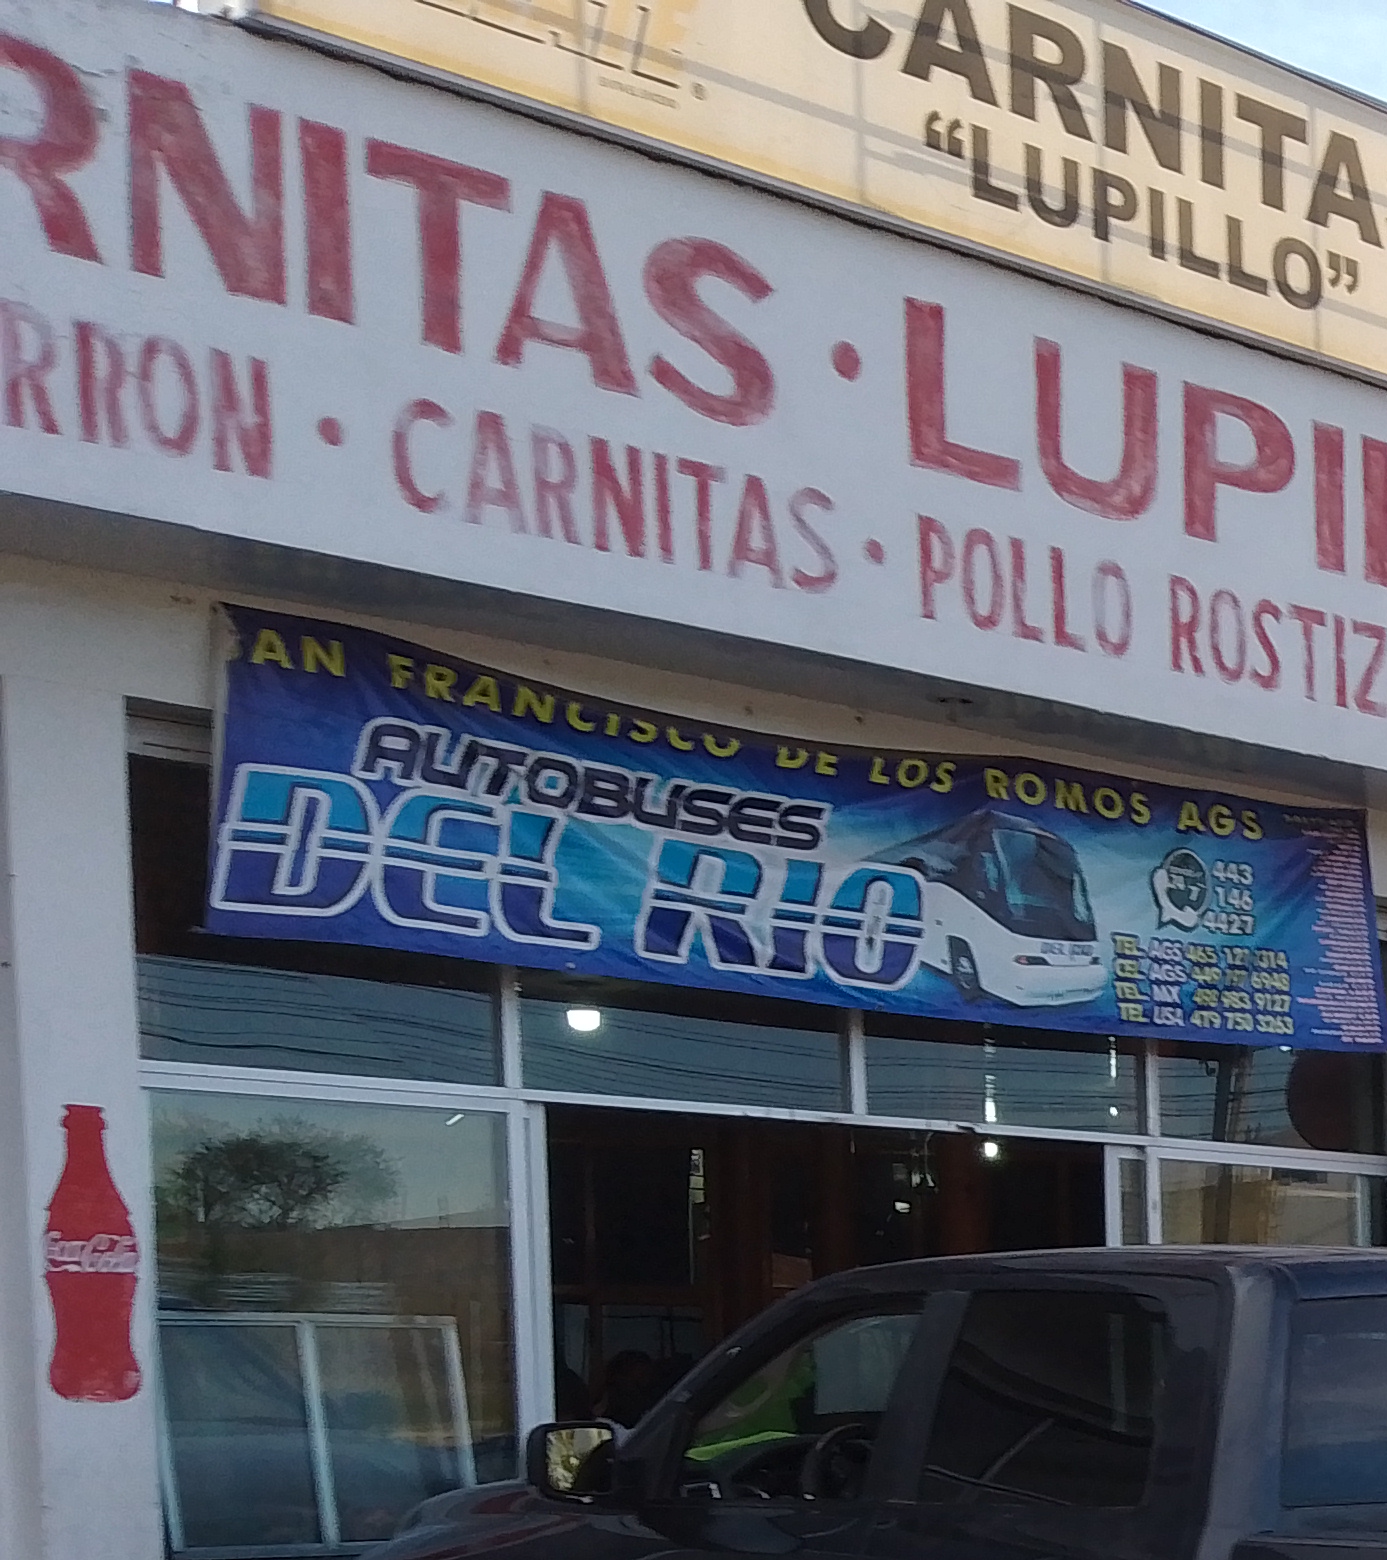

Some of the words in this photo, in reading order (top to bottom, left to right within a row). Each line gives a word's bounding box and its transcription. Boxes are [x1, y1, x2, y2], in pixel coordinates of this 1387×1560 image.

[391, 399, 838, 593] CARNITAS
[914, 513, 1133, 658] POLLO
[230, 628, 346, 678] AN
[776, 746, 839, 777] DE
[869, 757, 957, 795] LOS
[982, 766, 1152, 826] ROMOS
[1176, 801, 1266, 841] AGS
[354, 717, 832, 852] AUTOBUSES
[209, 762, 602, 951] DEL
[634, 836, 927, 993] RIO
[1201, 910, 1257, 936] 4427
[1211, 858, 1254, 886] 443
